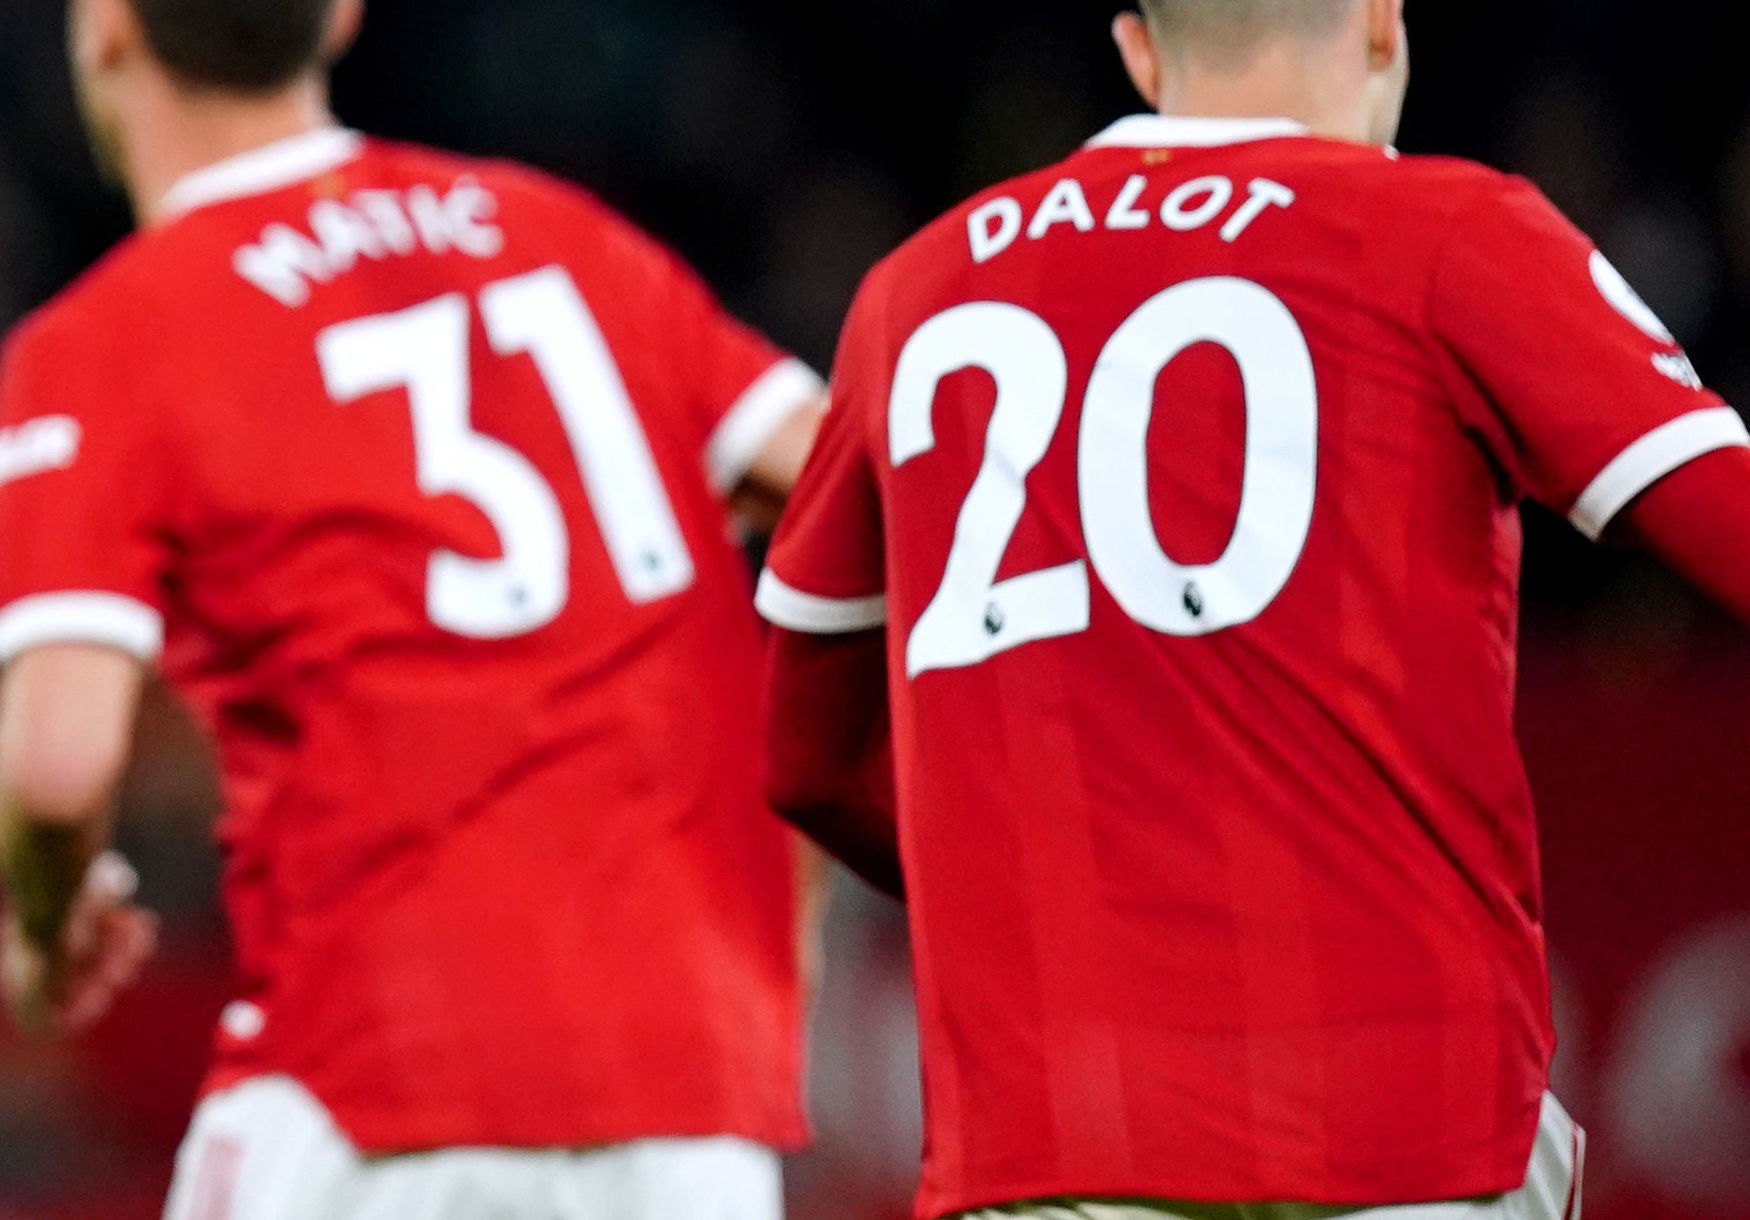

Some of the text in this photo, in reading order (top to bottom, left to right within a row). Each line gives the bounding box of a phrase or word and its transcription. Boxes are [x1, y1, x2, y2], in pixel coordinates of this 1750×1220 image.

[966, 174, 1296, 264] DALOT
[314, 264, 695, 642] 31
[887, 275, 1319, 681] 20
